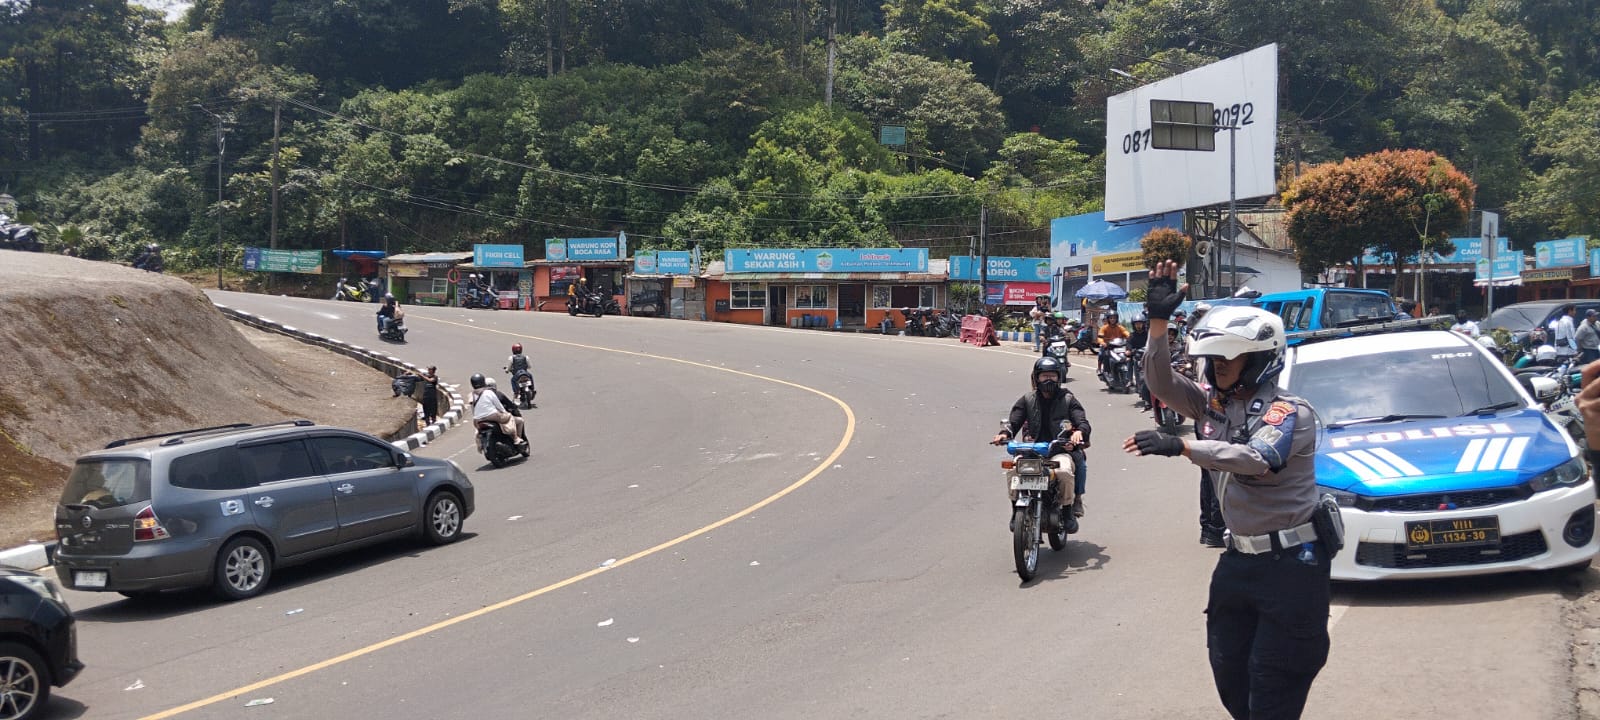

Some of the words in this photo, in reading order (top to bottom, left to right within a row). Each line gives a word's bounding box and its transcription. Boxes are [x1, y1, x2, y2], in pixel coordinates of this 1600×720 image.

[753, 252, 796, 261] WARUNG
[744, 261, 775, 269] SEKAR
[777, 261, 800, 269] ASIH
[800, 261, 806, 269] 1
[986, 260, 1012, 268] TOKO
[1331, 423, 1514, 448] POLISI
[1452, 520, 1473, 530] VIII
[1442, 531, 1486, 543] 1134-30
